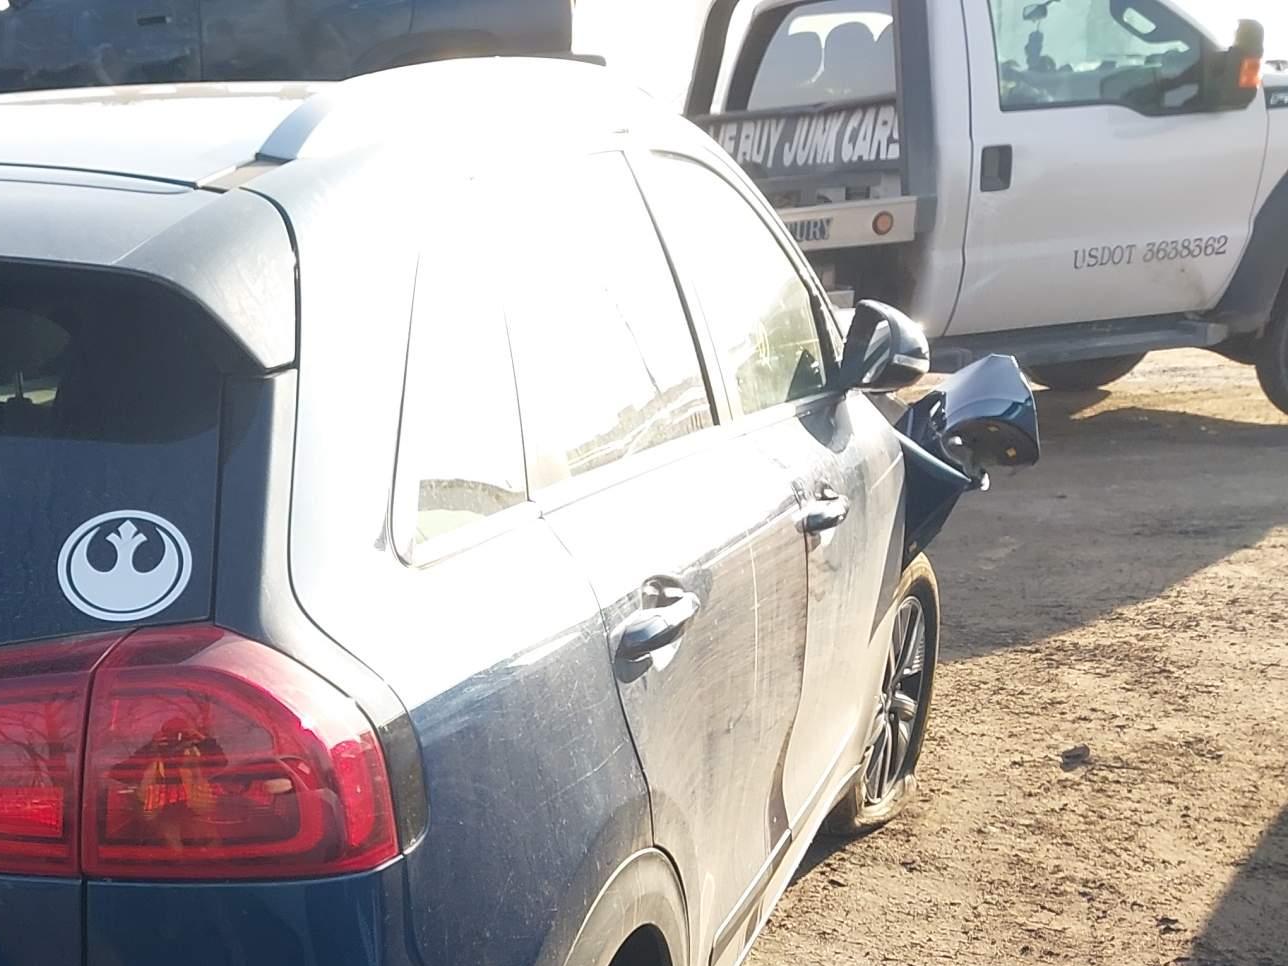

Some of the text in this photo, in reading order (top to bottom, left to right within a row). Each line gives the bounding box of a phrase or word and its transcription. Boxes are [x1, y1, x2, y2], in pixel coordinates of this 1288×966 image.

[783, 110, 847, 167] JUNK
[1073, 234, 1229, 269] USDOT 3638362
